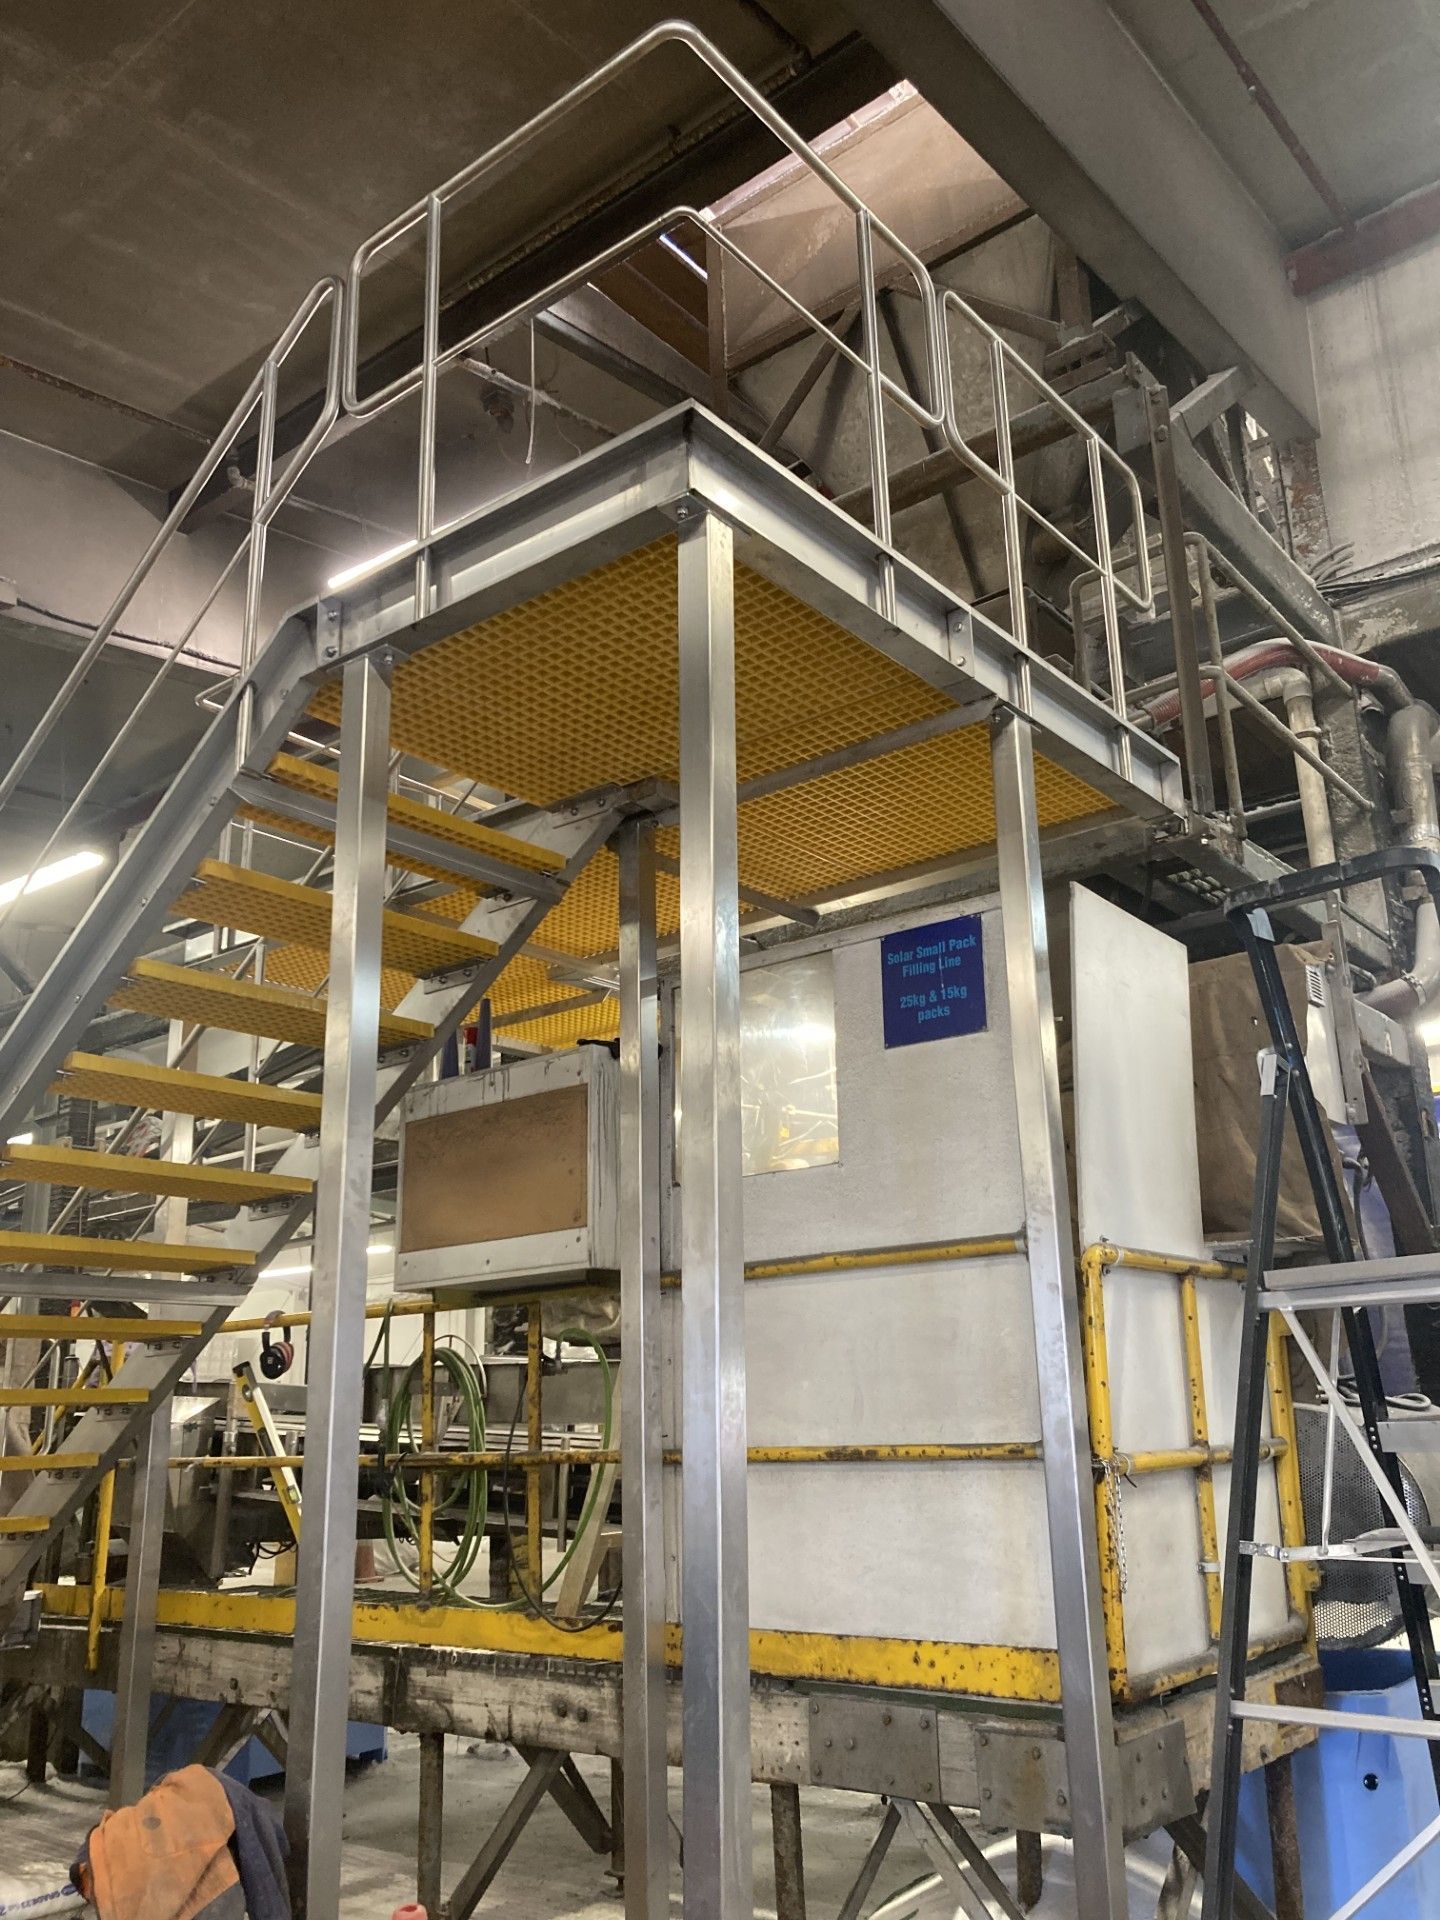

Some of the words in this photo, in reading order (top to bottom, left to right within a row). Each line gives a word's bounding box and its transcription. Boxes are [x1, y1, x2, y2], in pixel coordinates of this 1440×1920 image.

[887, 950, 913, 965] Solar
[916, 941, 946, 959] Small
[949, 934, 977, 952] Pack
[902, 961, 936, 978] Filling
[939, 955, 961, 970] Line
[900, 994, 926, 1009] 25kg
[929, 990, 937, 1002] &
[941, 985, 968, 999] 15kg
[918, 1005, 950, 1023] packs
